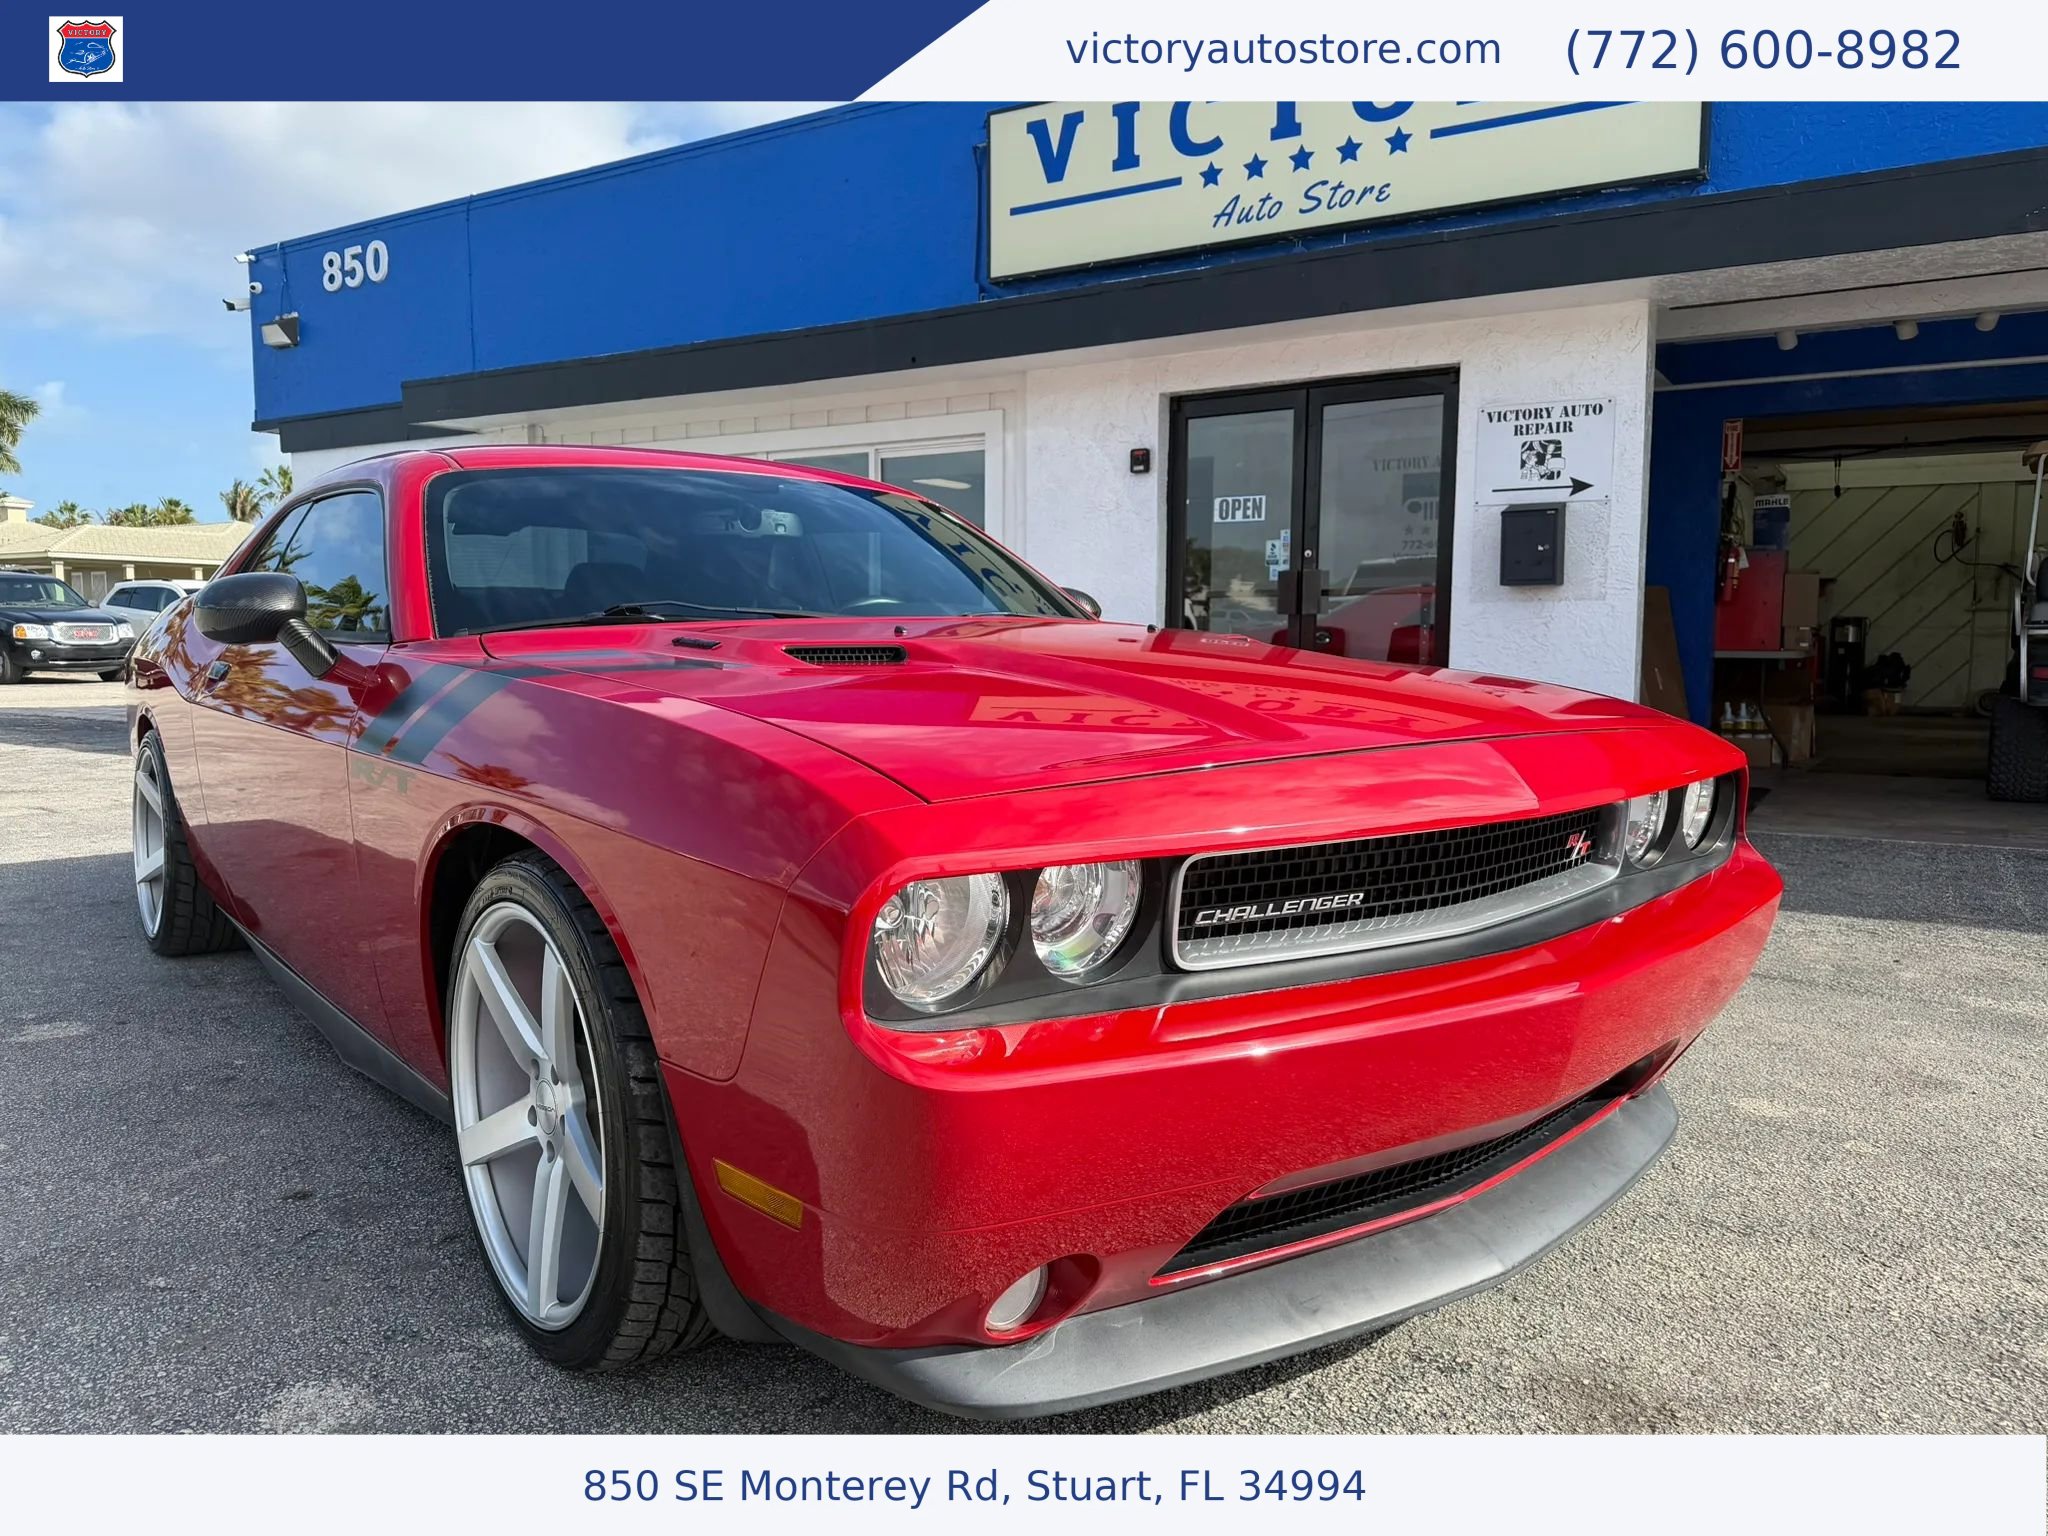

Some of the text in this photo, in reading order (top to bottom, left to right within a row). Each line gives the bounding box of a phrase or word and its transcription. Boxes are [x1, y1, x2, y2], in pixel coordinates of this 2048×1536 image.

[1026, 101, 1480, 184] VICT
[1212, 179, 1392, 229] Auto Store
[322, 239, 389, 292] 850
[1486, 402, 1604, 424] VICTORY AUTO
[1513, 420, 1574, 437] REPAIR
[1218, 497, 1263, 521] OPEN
[1755, 498, 1789, 508] MAHLE
[350, 760, 417, 794] R/T
[1566, 829, 1592, 859] R/T
[1194, 892, 1365, 925] CHALLENGER
